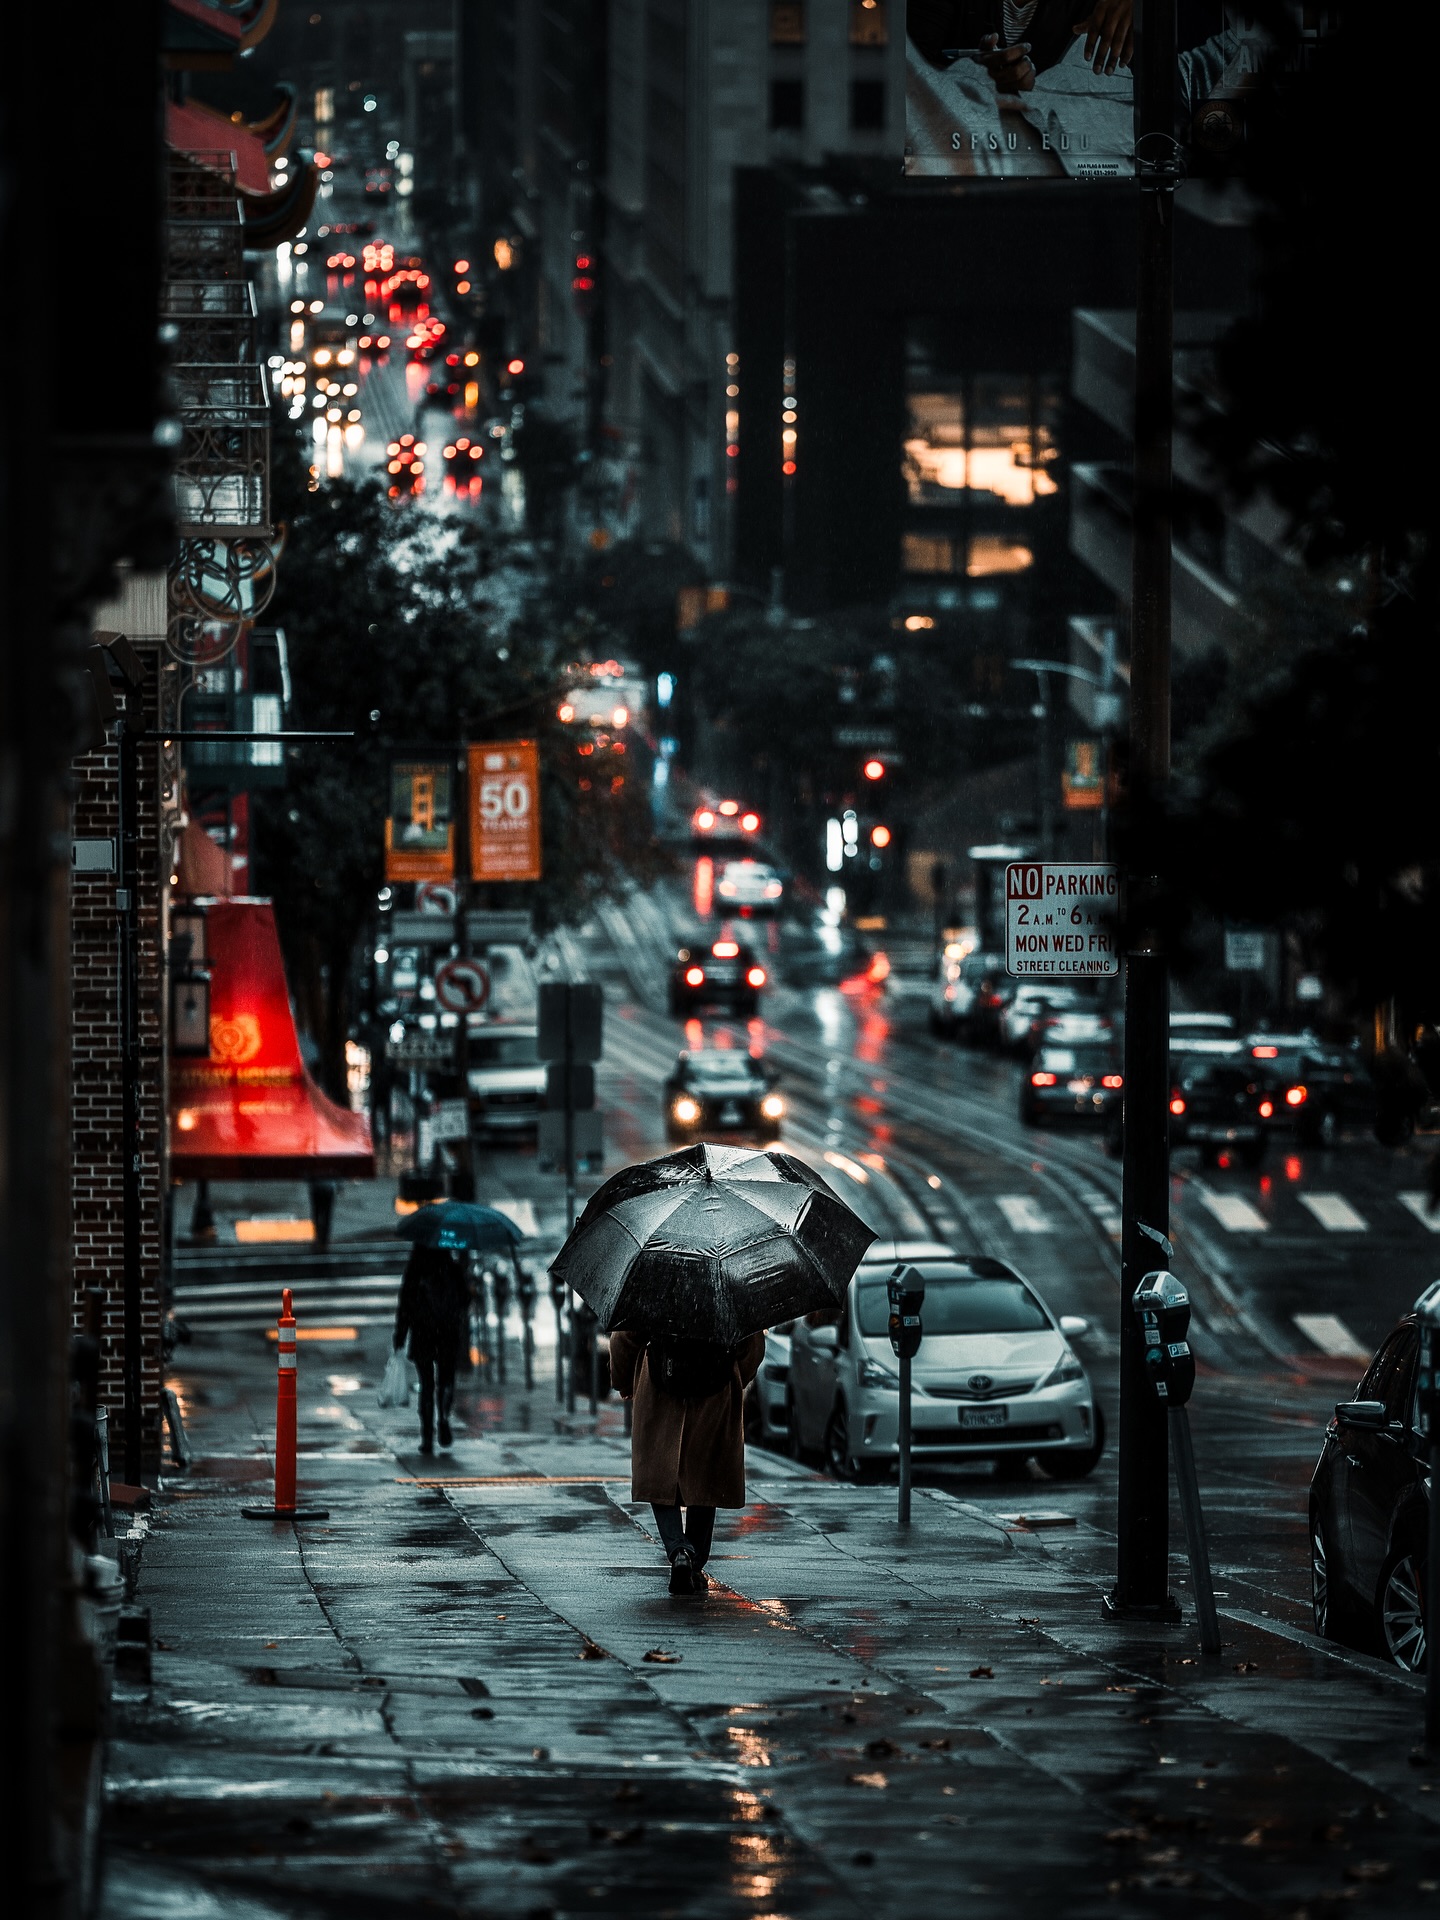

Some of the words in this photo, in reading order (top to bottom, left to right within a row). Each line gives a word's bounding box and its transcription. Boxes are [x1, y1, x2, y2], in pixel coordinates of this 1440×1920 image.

[951, 131, 1090, 151] SFSU.EDU
[478, 782, 530, 819] 50
[1010, 867, 1040, 896] NO
[1046, 874, 1116, 896] PARKING
[1017, 904, 1030, 925] 2
[1033, 914, 1059, 926] A.M.
[1057, 907, 1067, 916] TO
[1070, 904, 1083, 926] 6
[1015, 935, 1048, 952] MON
[1052, 935, 1084, 952] WED
[1088, 935, 1112, 952] FRI
[1016, 960, 1056, 972] STREET
[1058, 960, 1111, 972] CLEANING
